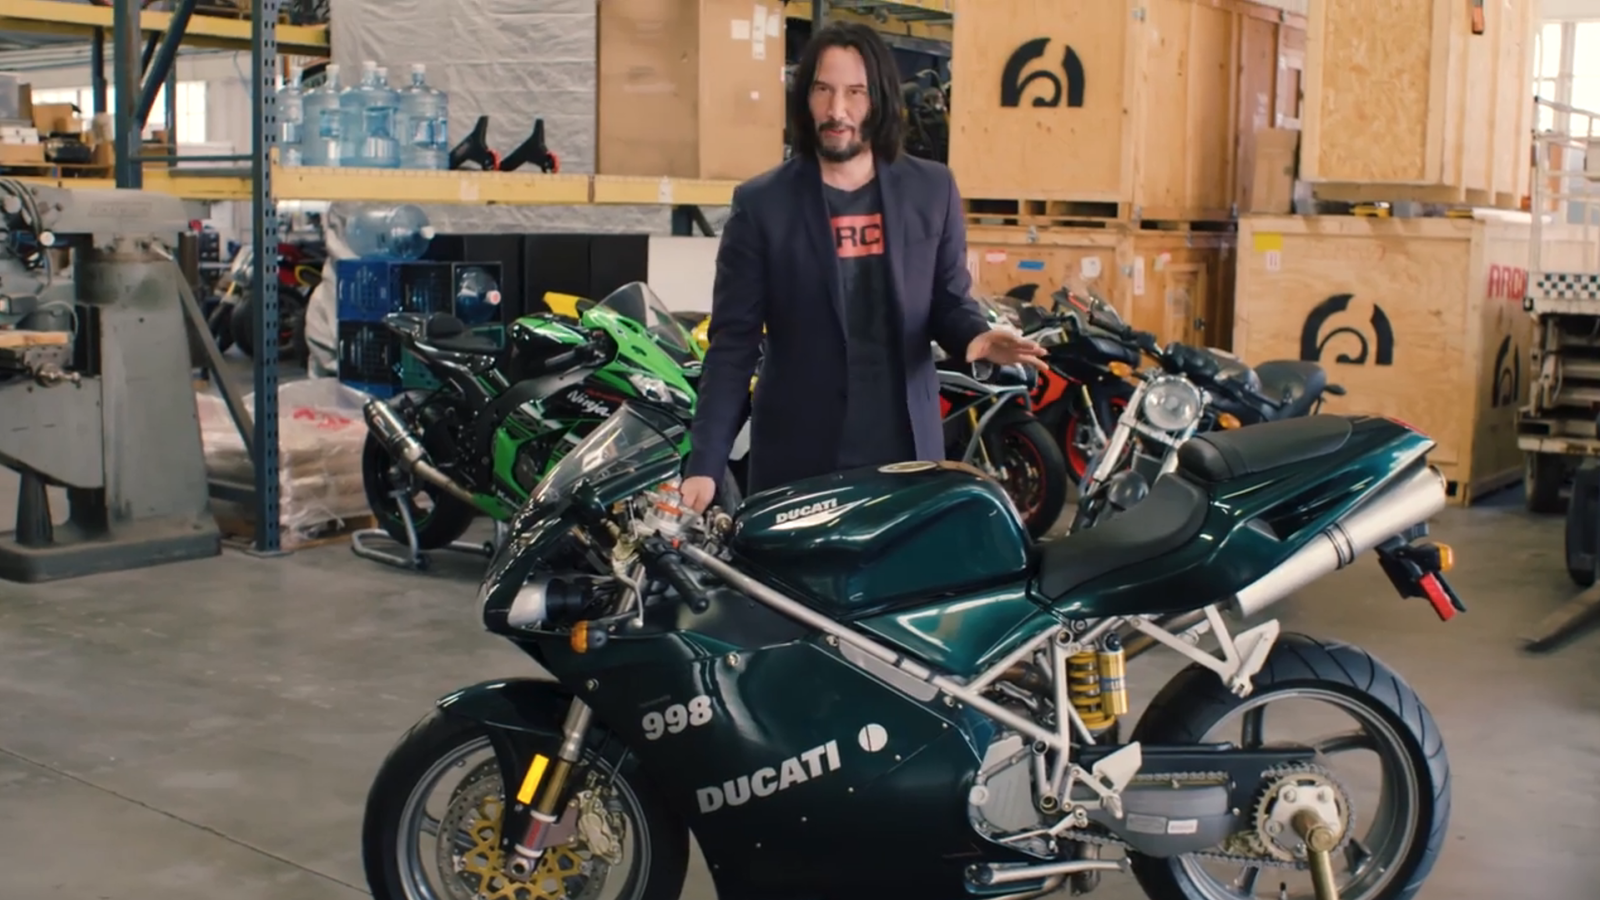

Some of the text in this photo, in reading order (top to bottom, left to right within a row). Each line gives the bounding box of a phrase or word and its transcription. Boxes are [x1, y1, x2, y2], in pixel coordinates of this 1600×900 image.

[567, 389, 610, 417] Ninja
[776, 498, 838, 523] DUCATI
[642, 695, 713, 740] 998
[696, 739, 841, 814] DUCATI
